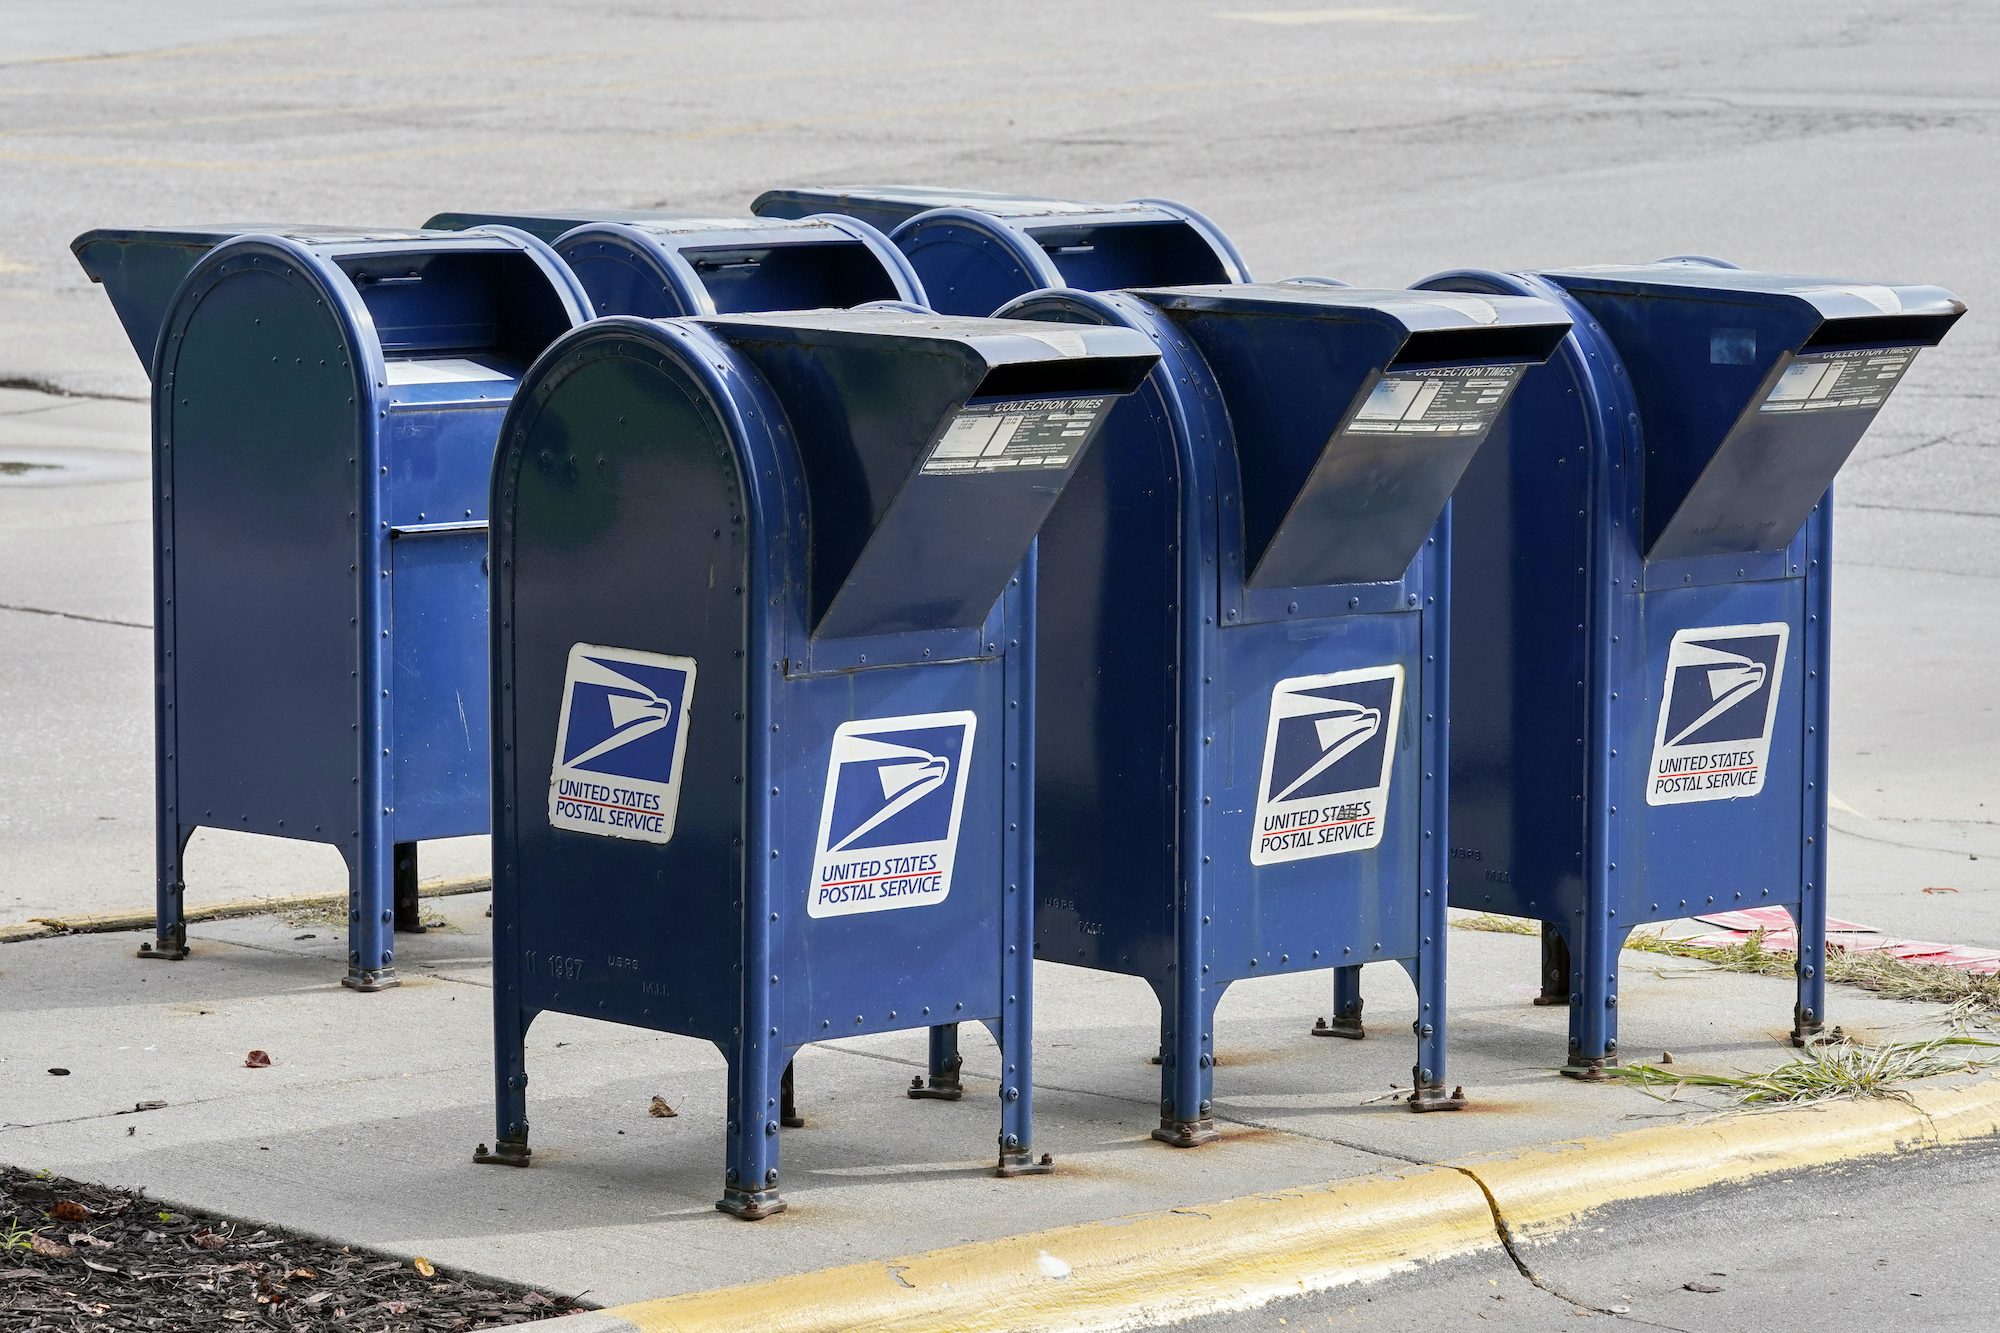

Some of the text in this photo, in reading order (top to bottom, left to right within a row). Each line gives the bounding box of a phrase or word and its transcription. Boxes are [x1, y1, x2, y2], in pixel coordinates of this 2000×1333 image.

[1415, 366, 1516, 377] COLLECTION TIMES
[994, 399, 1066, 412] COLLECTION
[1068, 398, 1103, 409] TIMES
[1658, 750, 1755, 774] UNITED STATES
[559, 779, 660, 810] UNITED STATES
[1655, 770, 1758, 794] POSTAL SERVICE
[556, 800, 665, 834] POSTAL SERVICE
[1264, 801, 1371, 831] UNITED STATES
[1260, 821, 1376, 853] POSTAL SERVICE
[822, 854, 938, 882] UNITED STATES
[818, 875, 942, 905] POSTAL SERVICE
[548, 954, 585, 981] 1997
